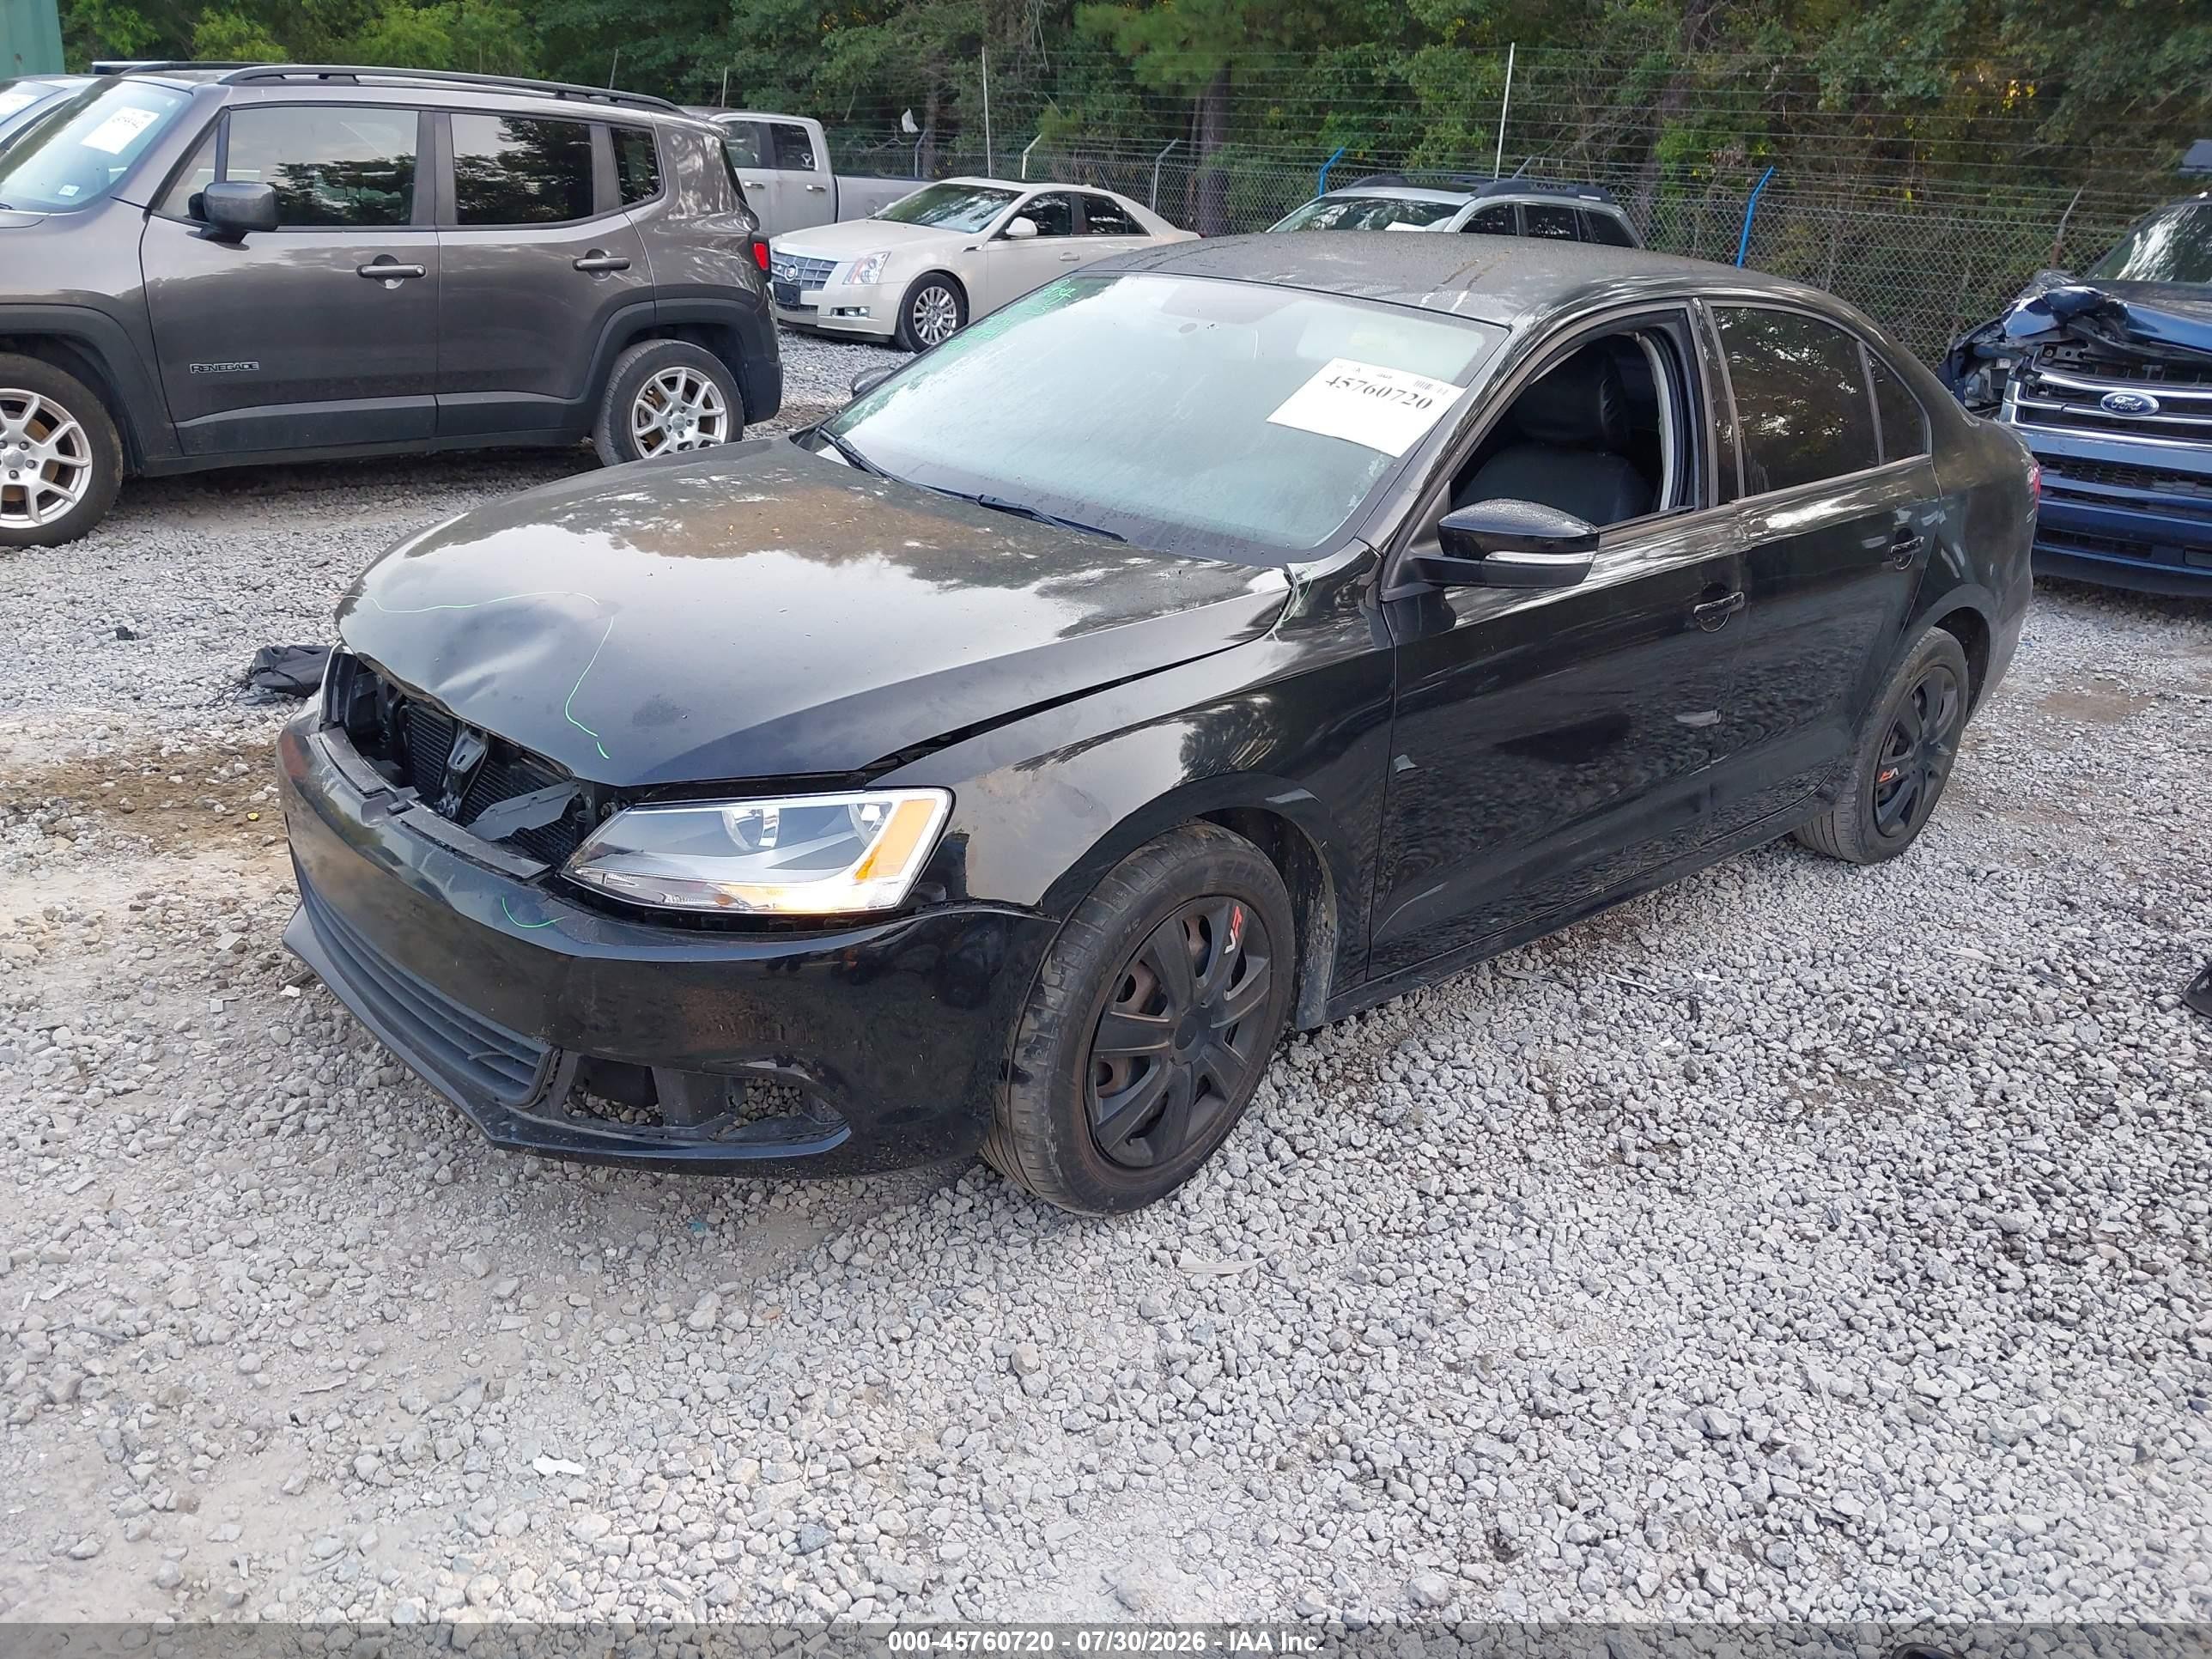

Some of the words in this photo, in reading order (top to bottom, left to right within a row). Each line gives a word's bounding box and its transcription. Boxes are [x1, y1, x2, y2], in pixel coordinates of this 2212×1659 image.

[190, 362, 259, 374] RENEGADE
[1325, 376, 1433, 410] 45760720
[2111, 396, 2143, 411] Ford
